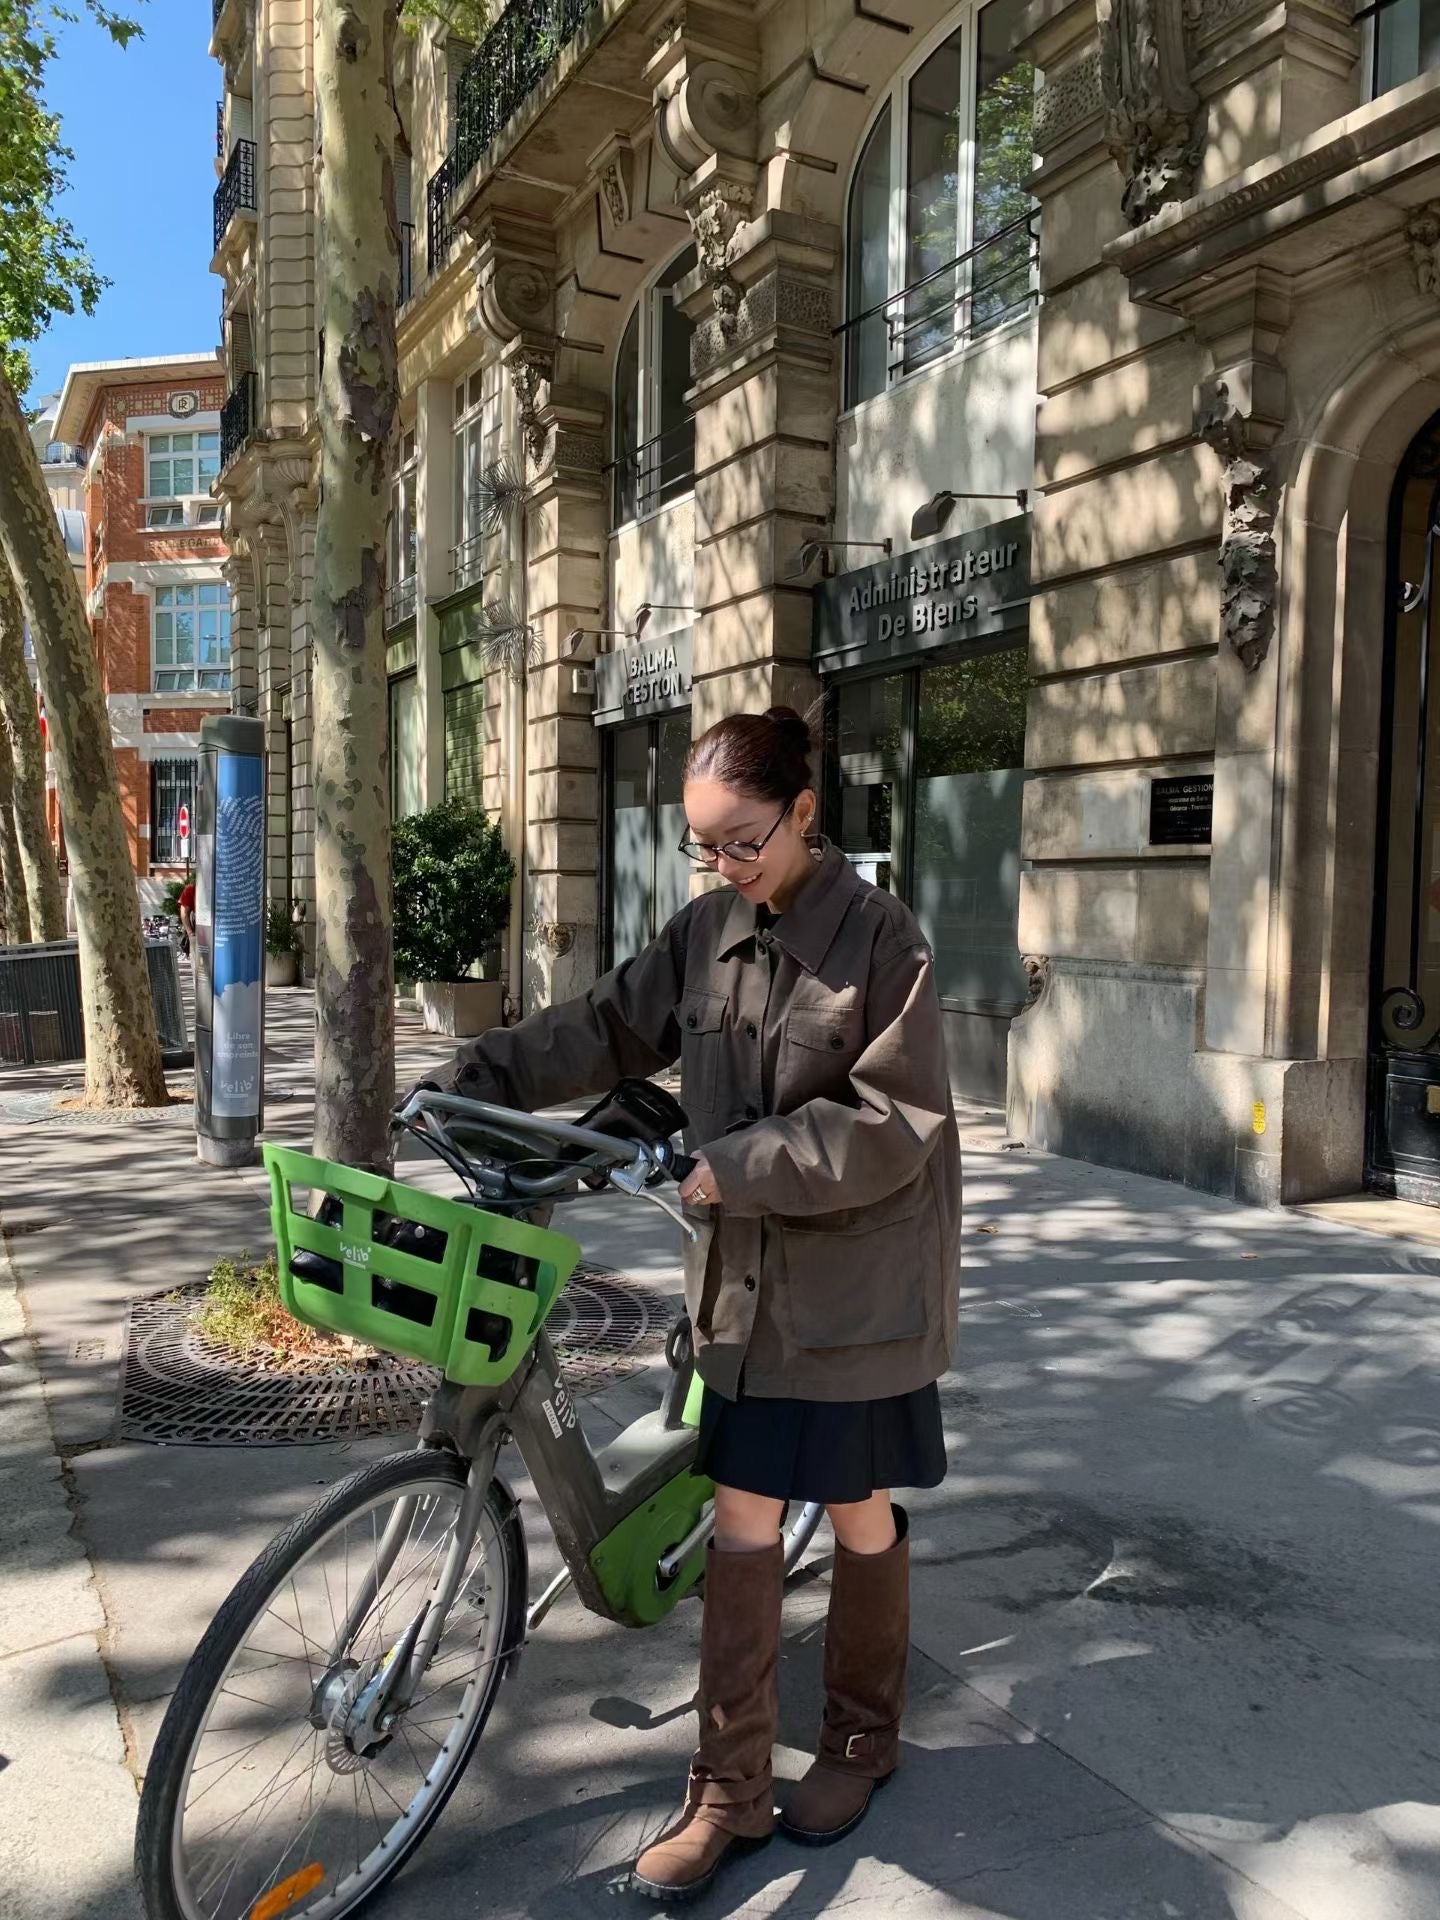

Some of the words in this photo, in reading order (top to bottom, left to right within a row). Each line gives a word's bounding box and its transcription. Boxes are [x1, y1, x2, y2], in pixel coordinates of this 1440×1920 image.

[849, 539, 1018, 616] Administrateur
[878, 612, 906, 641] De
[911, 593, 978, 633] Biens
[630, 645, 677, 678] BALMA
[625, 672, 682, 705] GESTION
